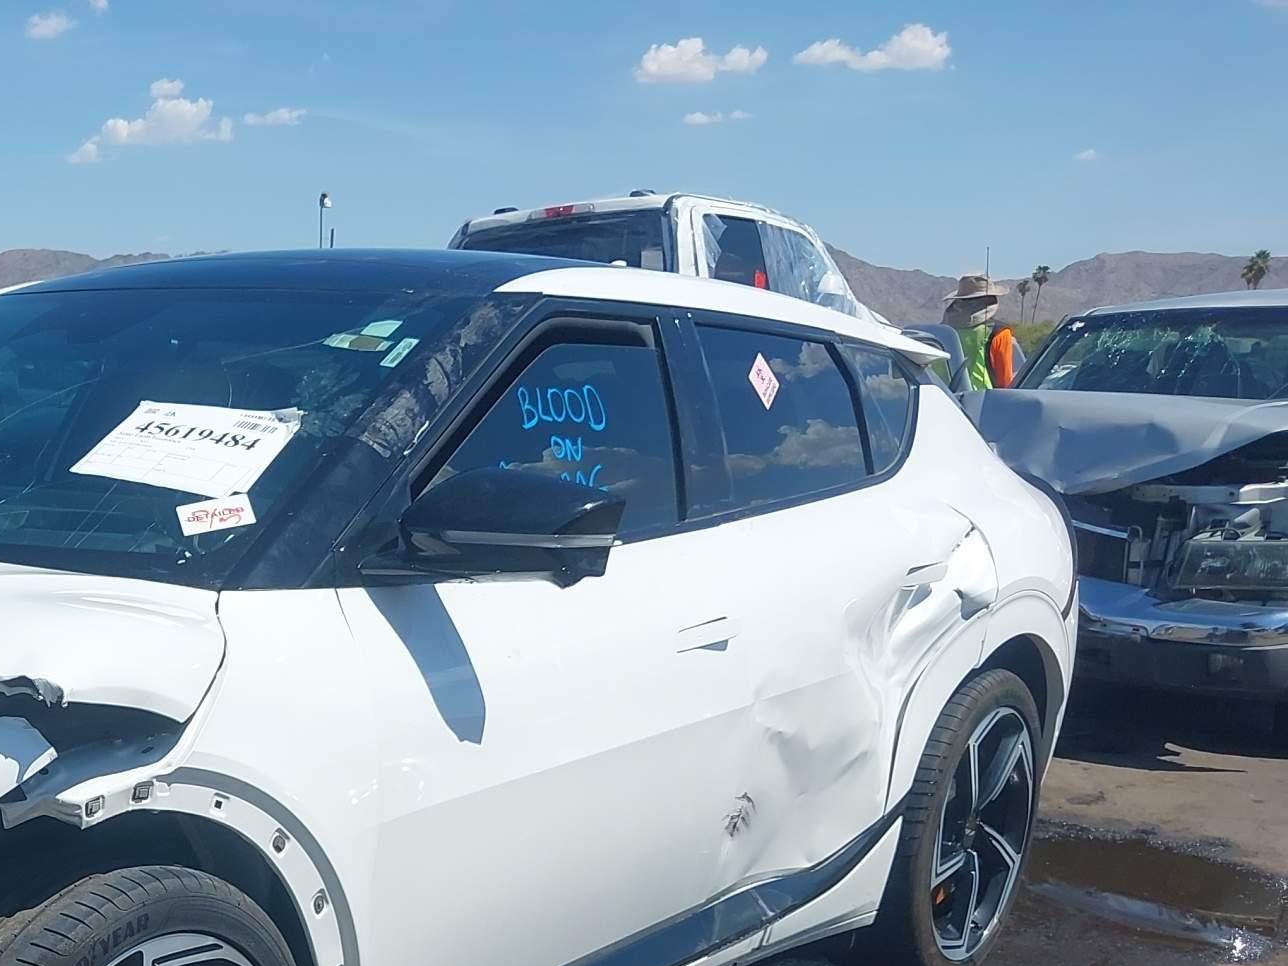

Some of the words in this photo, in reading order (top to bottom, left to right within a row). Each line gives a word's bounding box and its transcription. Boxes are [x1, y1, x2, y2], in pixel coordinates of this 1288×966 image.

[517, 384, 606, 431] BLOOD
[135, 420, 263, 451] 45619484
[550, 435, 583, 462] ON
